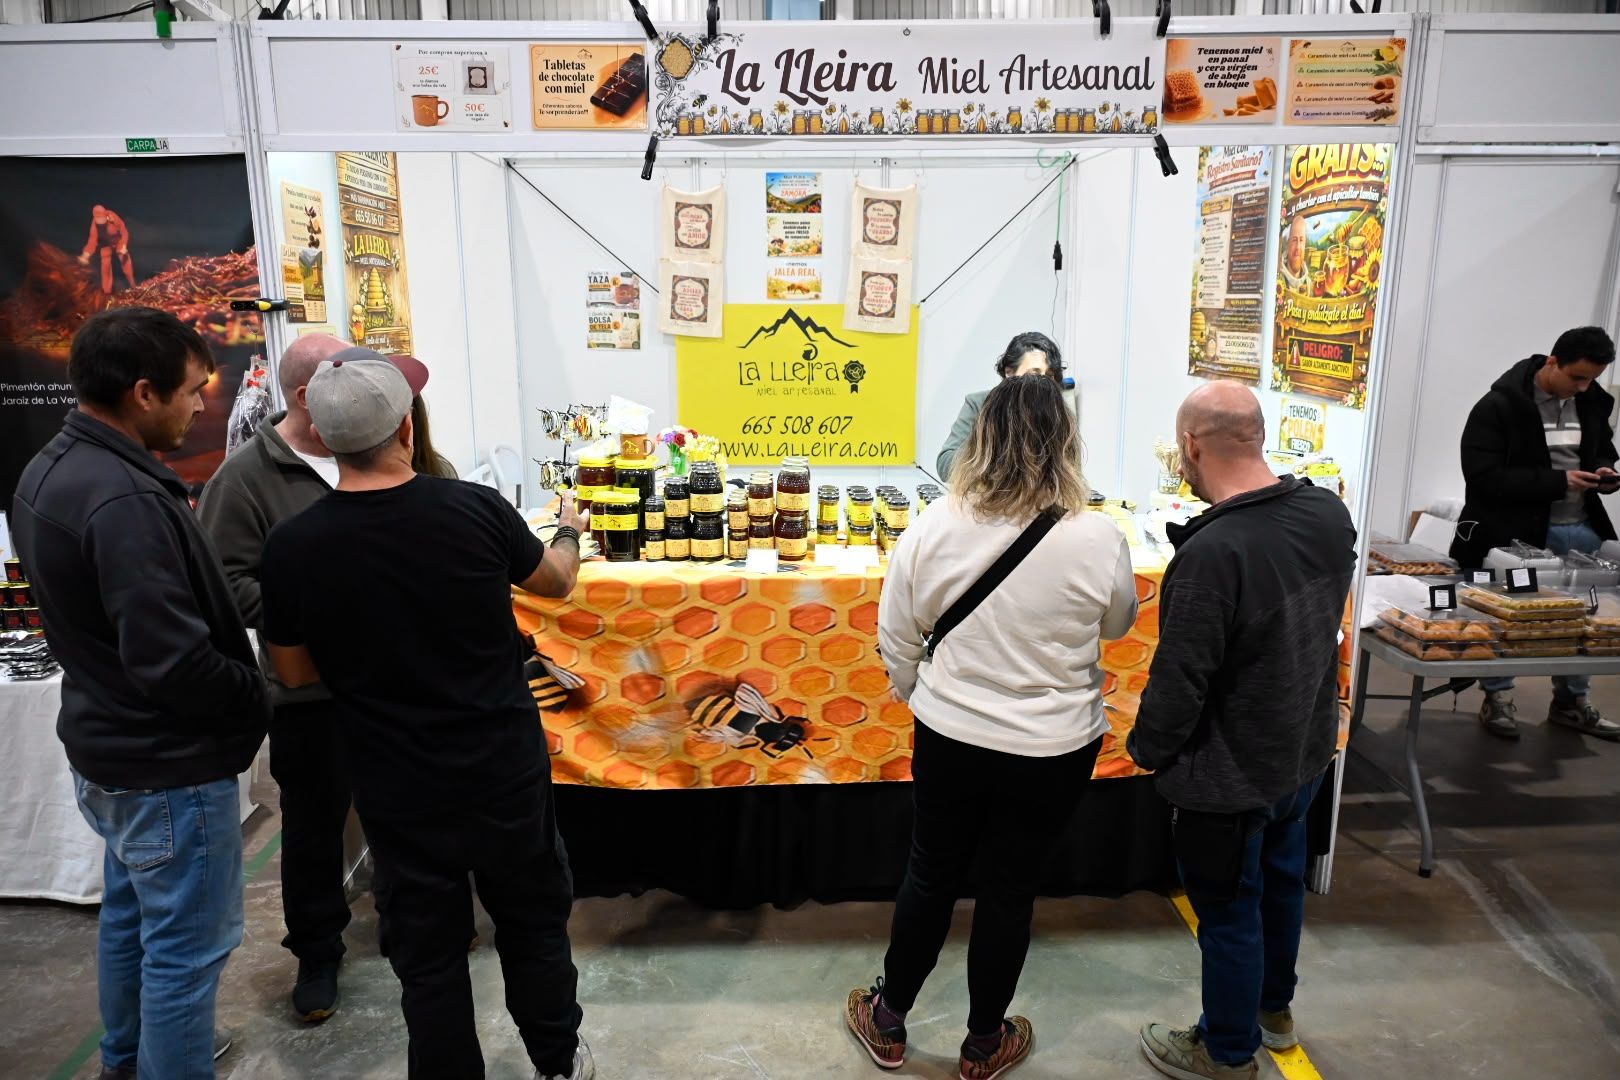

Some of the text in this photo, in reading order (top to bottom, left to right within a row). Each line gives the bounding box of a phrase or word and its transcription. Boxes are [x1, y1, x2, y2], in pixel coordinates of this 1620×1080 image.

[1242, 46, 1263, 54] miel
[1221, 55, 1249, 64] panal
[543, 59, 585, 70] Tabletas
[1227, 64, 1258, 73] virgen
[418, 66, 438, 75] 25€
[539, 72, 594, 81] de chocolate
[716, 49, 1155, 106] La LLeira Miel Artesanal
[1221, 72, 1246, 80] abeja
[545, 83, 585, 93] con miel
[1217, 81, 1249, 89] bloque
[465, 104, 485, 112] 50€
[128, 141, 168, 150] CARPALIA
[354, 235, 391, 260] LA LLEIRA
[775, 268, 816, 276] JALEA REAL
[1284, 299, 1366, 325] ¡Pasa y endúlzate el día!
[1304, 342, 1343, 360] PELIGRO:
[738, 361, 760, 385] La
[0, 382, 45, 391] Pimentón
[31, 396, 44, 404] de
[47, 396, 58, 404] La
[1290, 406, 1317, 421] TENEMOS
[742, 416, 853, 435] 665 508 607
[1288, 419, 1316, 439] POLEN
